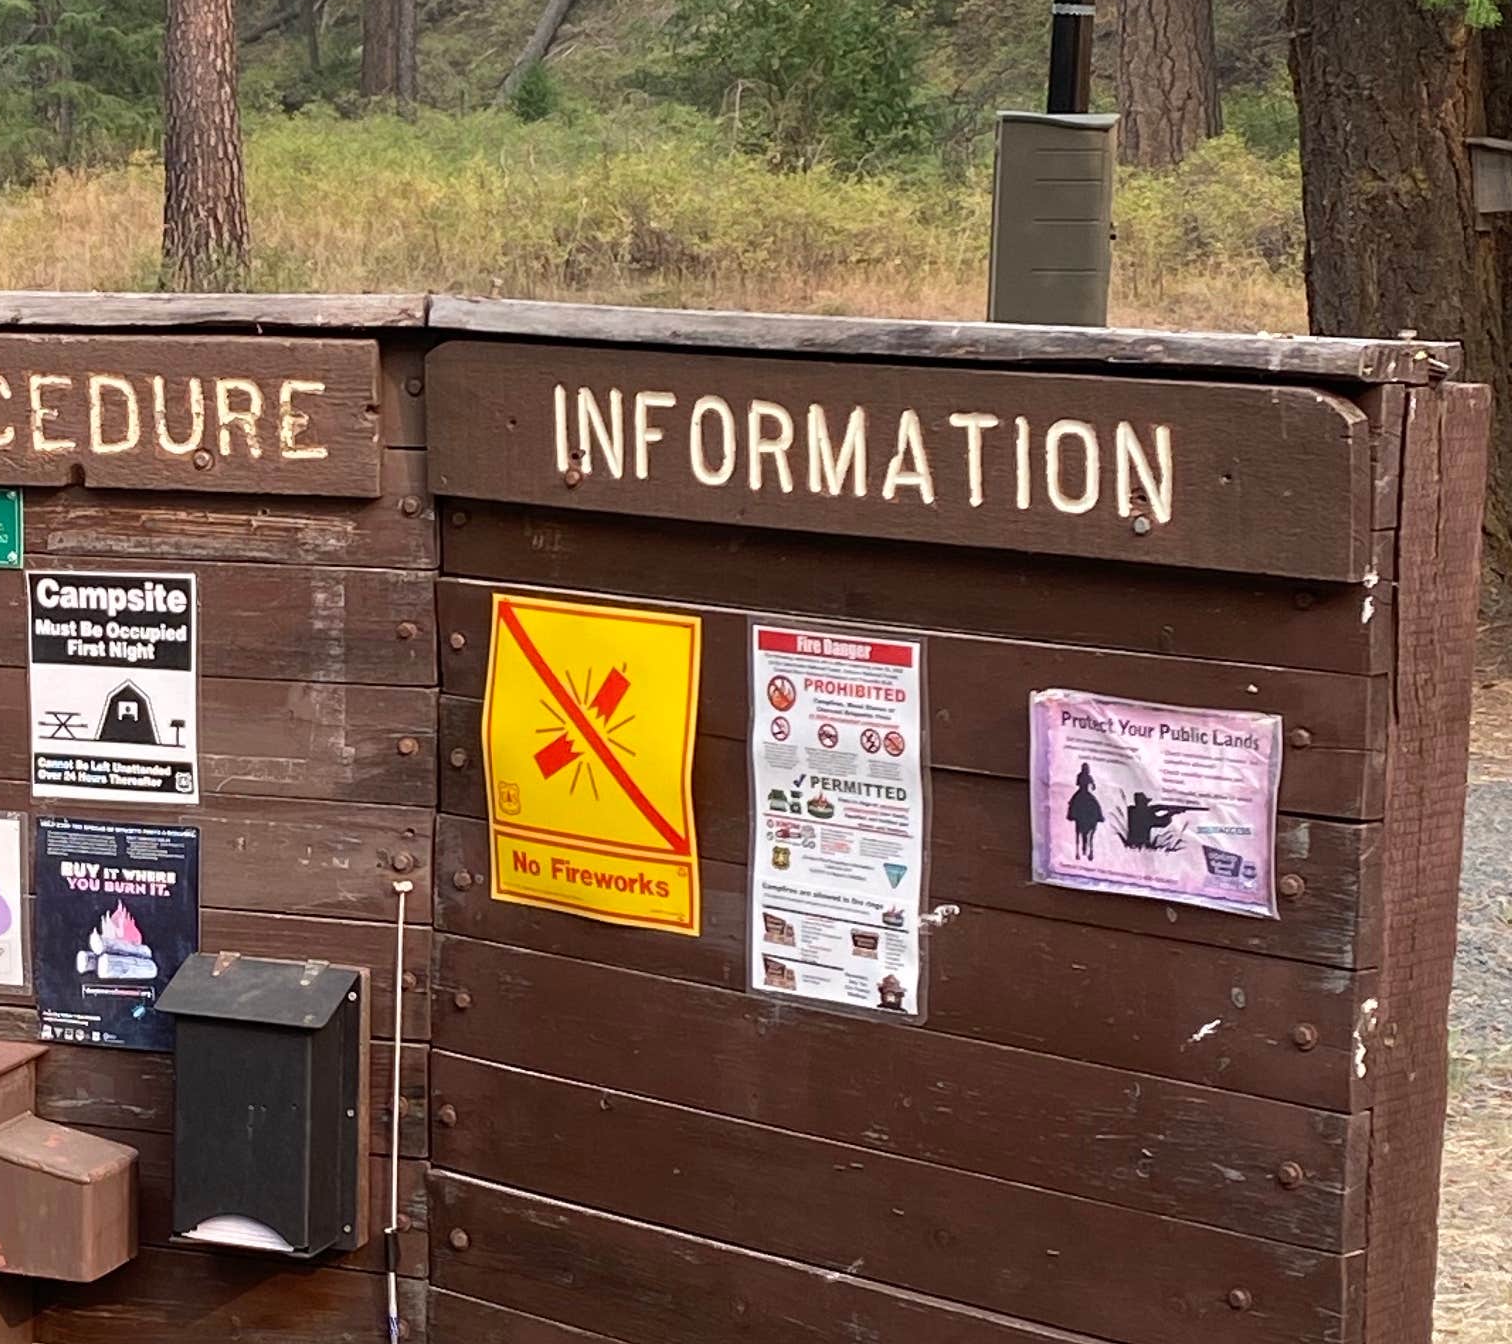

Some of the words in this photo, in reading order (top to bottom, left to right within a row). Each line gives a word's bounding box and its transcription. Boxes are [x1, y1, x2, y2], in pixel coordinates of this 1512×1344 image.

[554, 384, 1173, 524] INFORMATION
[36, 577, 188, 617] Campsite
[35, 619, 77, 636] Must
[79, 620, 103, 638] Be
[106, 621, 188, 643] Occupied
[67, 639, 106, 656] First
[109, 641, 155, 662] Night
[796, 635, 821, 654] Fire
[823, 639, 872, 659] Danger
[803, 678, 906, 703] PROHIBITED
[1060, 711, 1113, 734] Protect
[1118, 719, 1155, 739] Your
[1159, 724, 1208, 745] Public
[1212, 729, 1260, 751] Lands
[37, 757, 74, 769] Cannot
[75, 759, 89, 770] Be
[90, 761, 111, 772] Left
[112, 762, 172, 776] Unattended
[37, 769, 63, 780] Over
[63, 771, 76, 781] 24
[78, 772, 108, 784] Hours
[109, 774, 163, 787] Thereafter
[810, 776, 907, 801] PERMITTED
[60, 861, 100, 878] BUY
[103, 867, 119, 880] IT
[121, 869, 177, 884] WHERE
[511, 849, 540, 876] No
[551, 857, 670, 898] Fireworks
[66, 876, 100, 891] YOU
[104, 881, 146, 895] BURN
